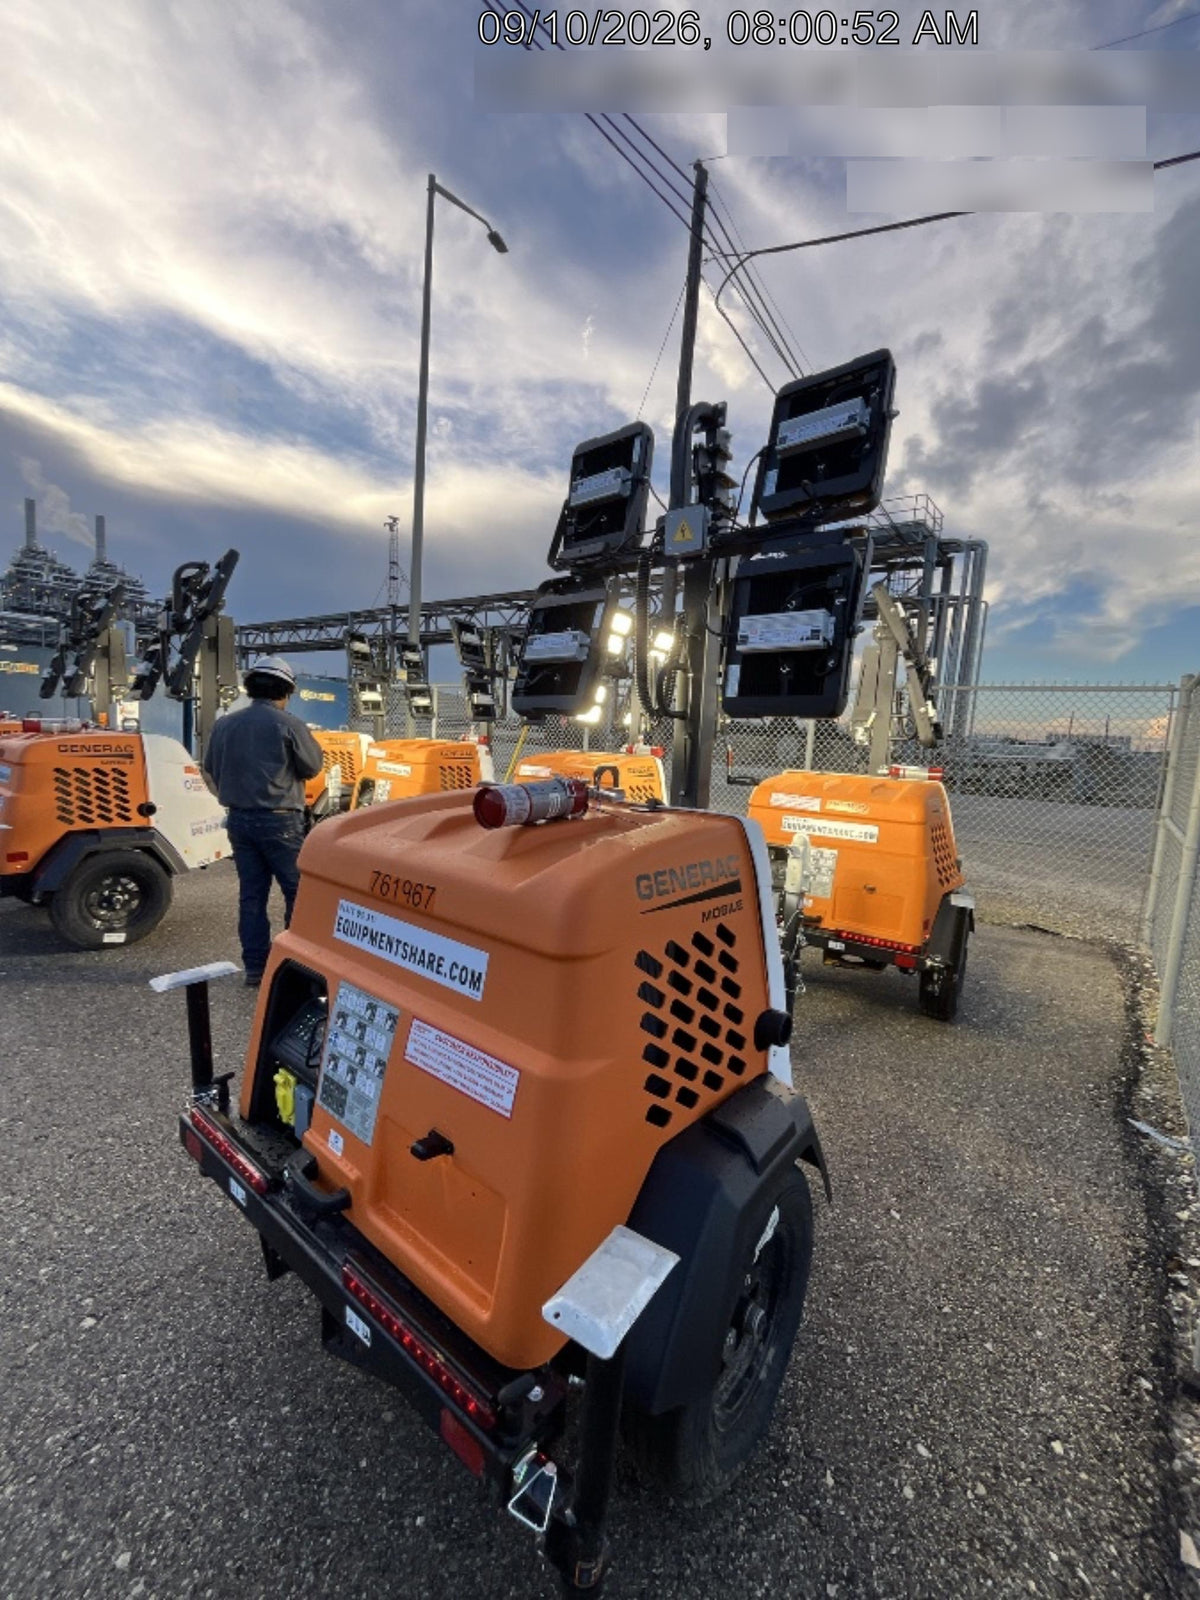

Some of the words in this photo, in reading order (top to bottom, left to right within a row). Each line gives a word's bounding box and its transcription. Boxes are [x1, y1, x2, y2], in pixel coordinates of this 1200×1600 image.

[58, 744, 134, 753] GENERAC
[370, 870, 437, 909] 761967
[635, 855, 741, 901] GENERAC
[702, 899, 744, 923] MOBILE
[336, 916, 484, 993] EQUIPMENTSHARE.COM
